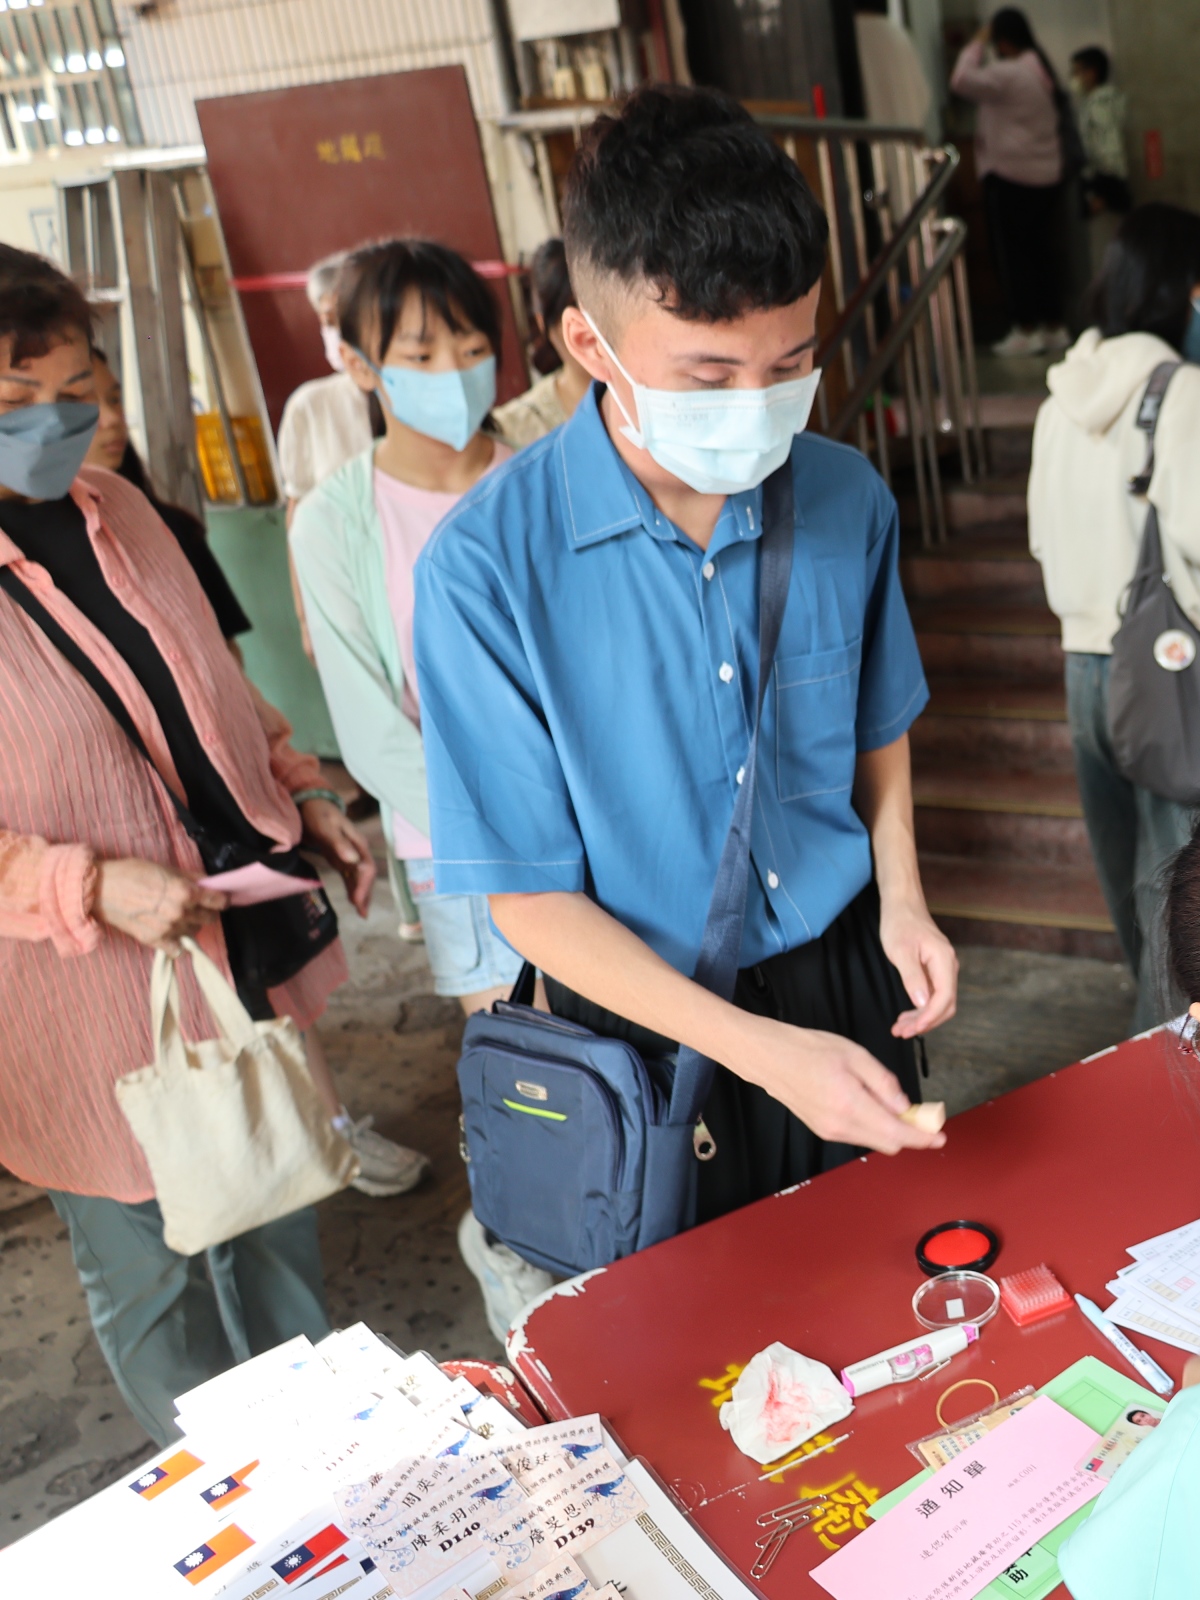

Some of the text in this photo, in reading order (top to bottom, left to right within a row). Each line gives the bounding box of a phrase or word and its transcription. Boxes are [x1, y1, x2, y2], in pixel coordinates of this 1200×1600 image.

[915, 1460, 987, 1519] 通知單
[438, 1521, 481, 1552] D140
[554, 1517, 595, 1549] D139
